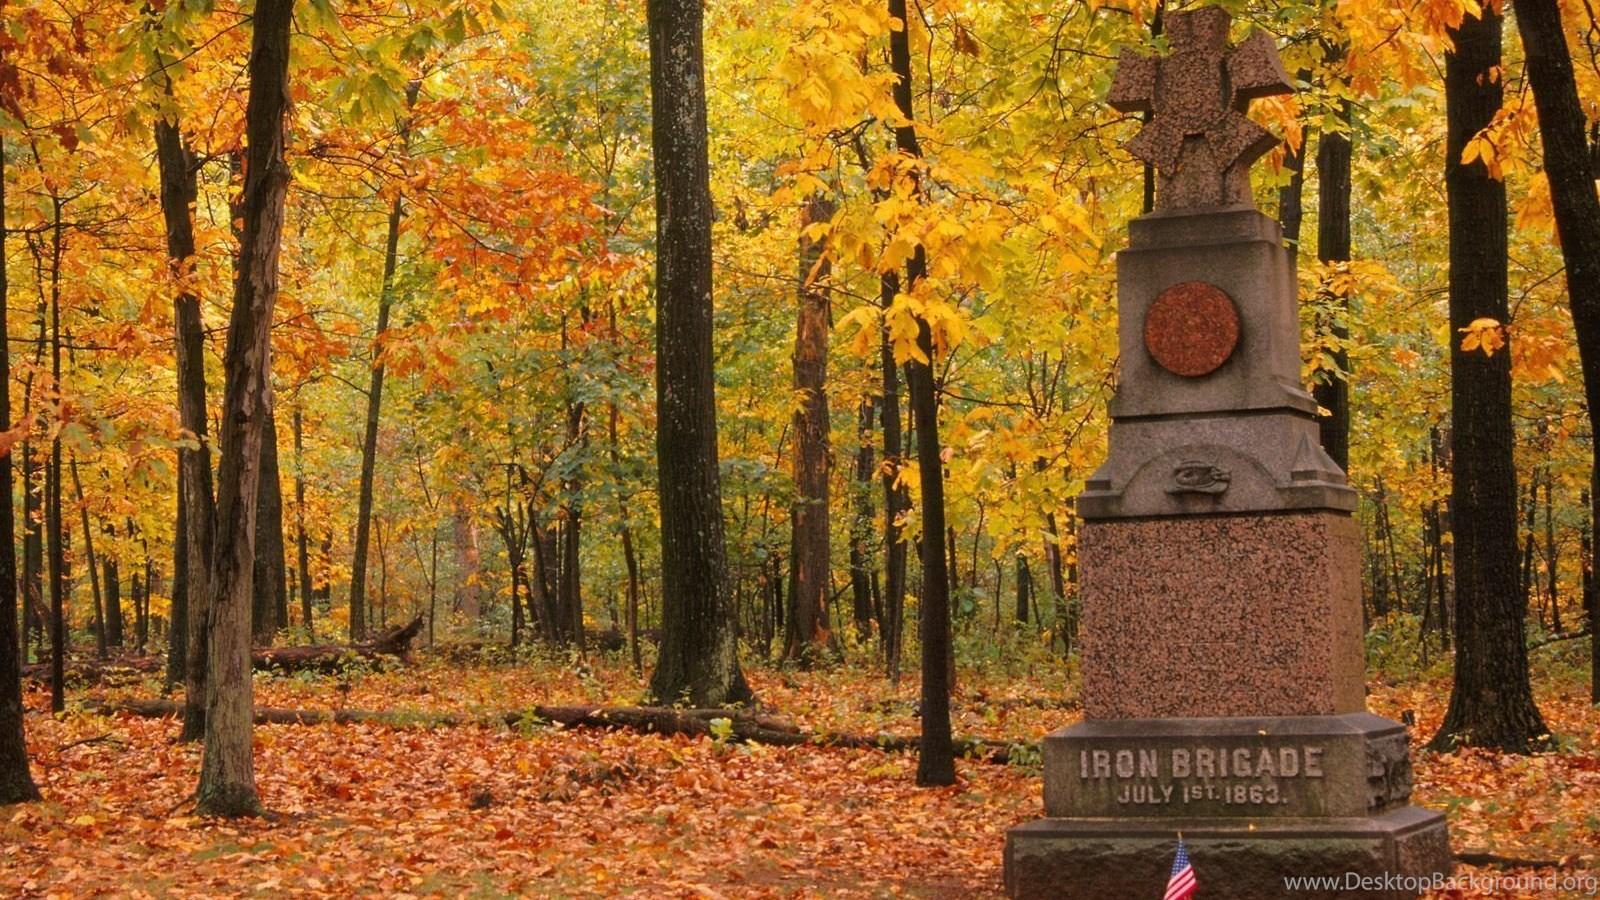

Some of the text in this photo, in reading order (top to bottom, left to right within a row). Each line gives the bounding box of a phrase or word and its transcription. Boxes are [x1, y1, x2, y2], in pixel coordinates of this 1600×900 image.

[1080, 747, 1324, 779] IRON BRIGADE
[1118, 785, 1174, 804] JULY
[1224, 784, 1288, 804] 1863.
